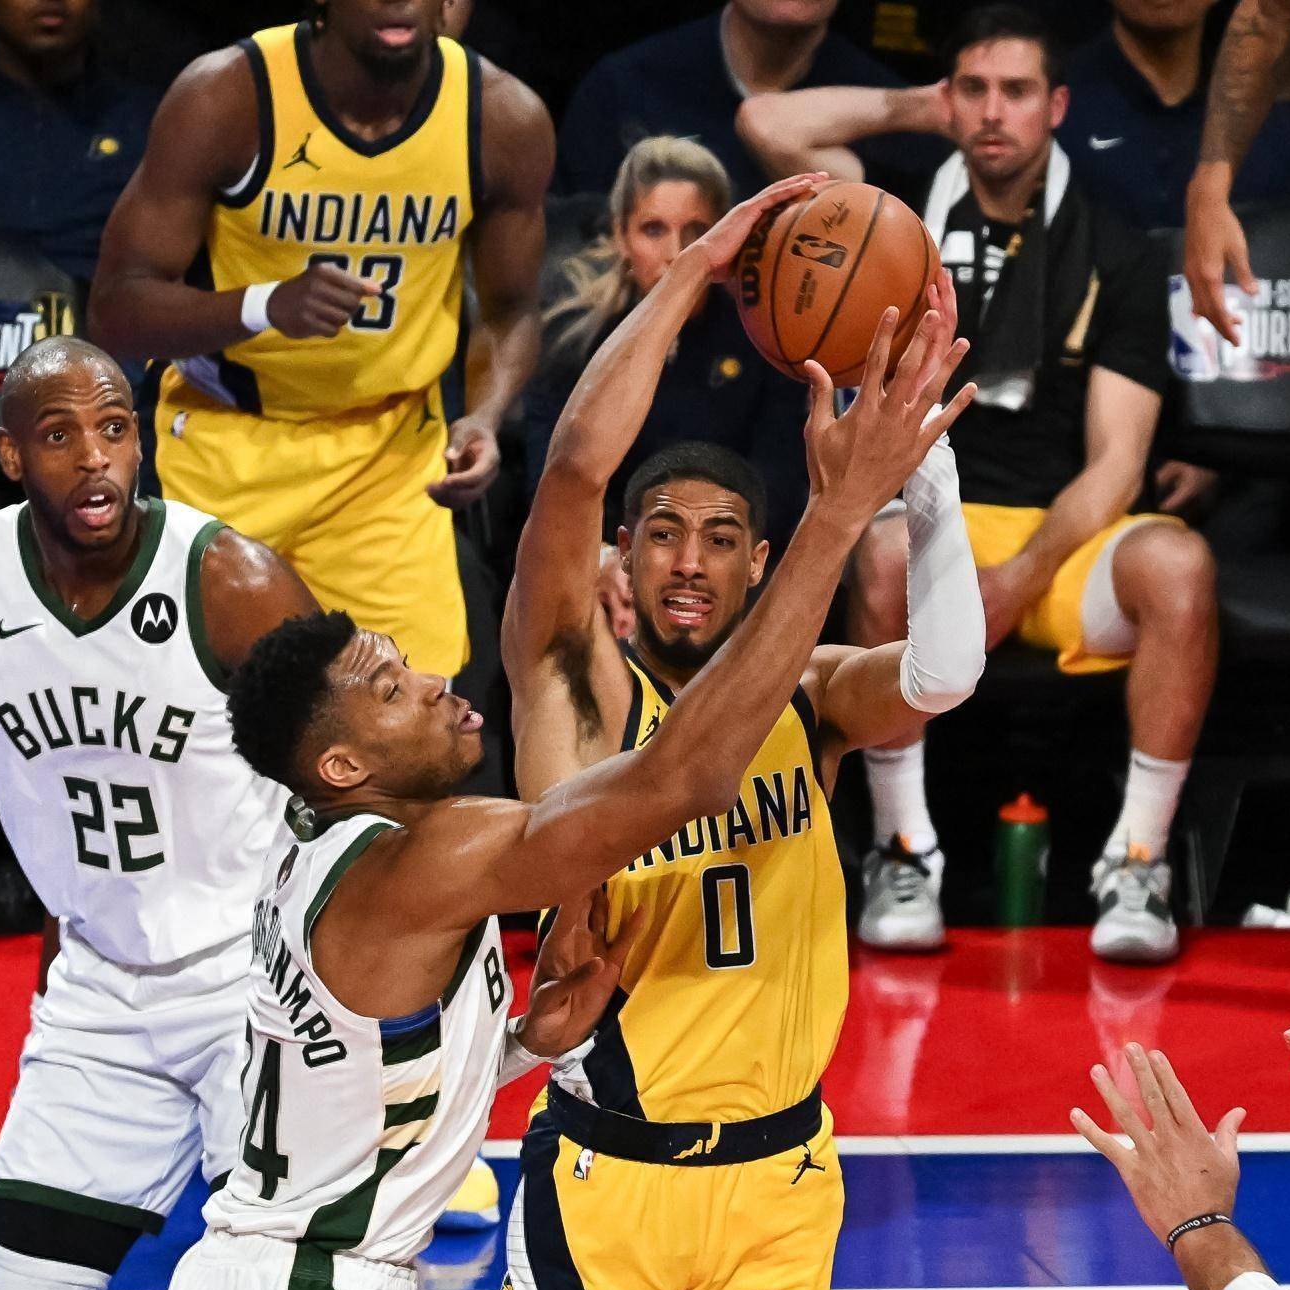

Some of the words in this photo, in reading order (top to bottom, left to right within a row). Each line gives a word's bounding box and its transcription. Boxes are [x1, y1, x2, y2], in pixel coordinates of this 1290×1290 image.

[261, 190, 457, 243] INDIANA
[63, 776, 165, 873] 22
[628, 766, 813, 873] DIANA
[700, 863, 757, 971] 0
[484, 946, 505, 1015] B
